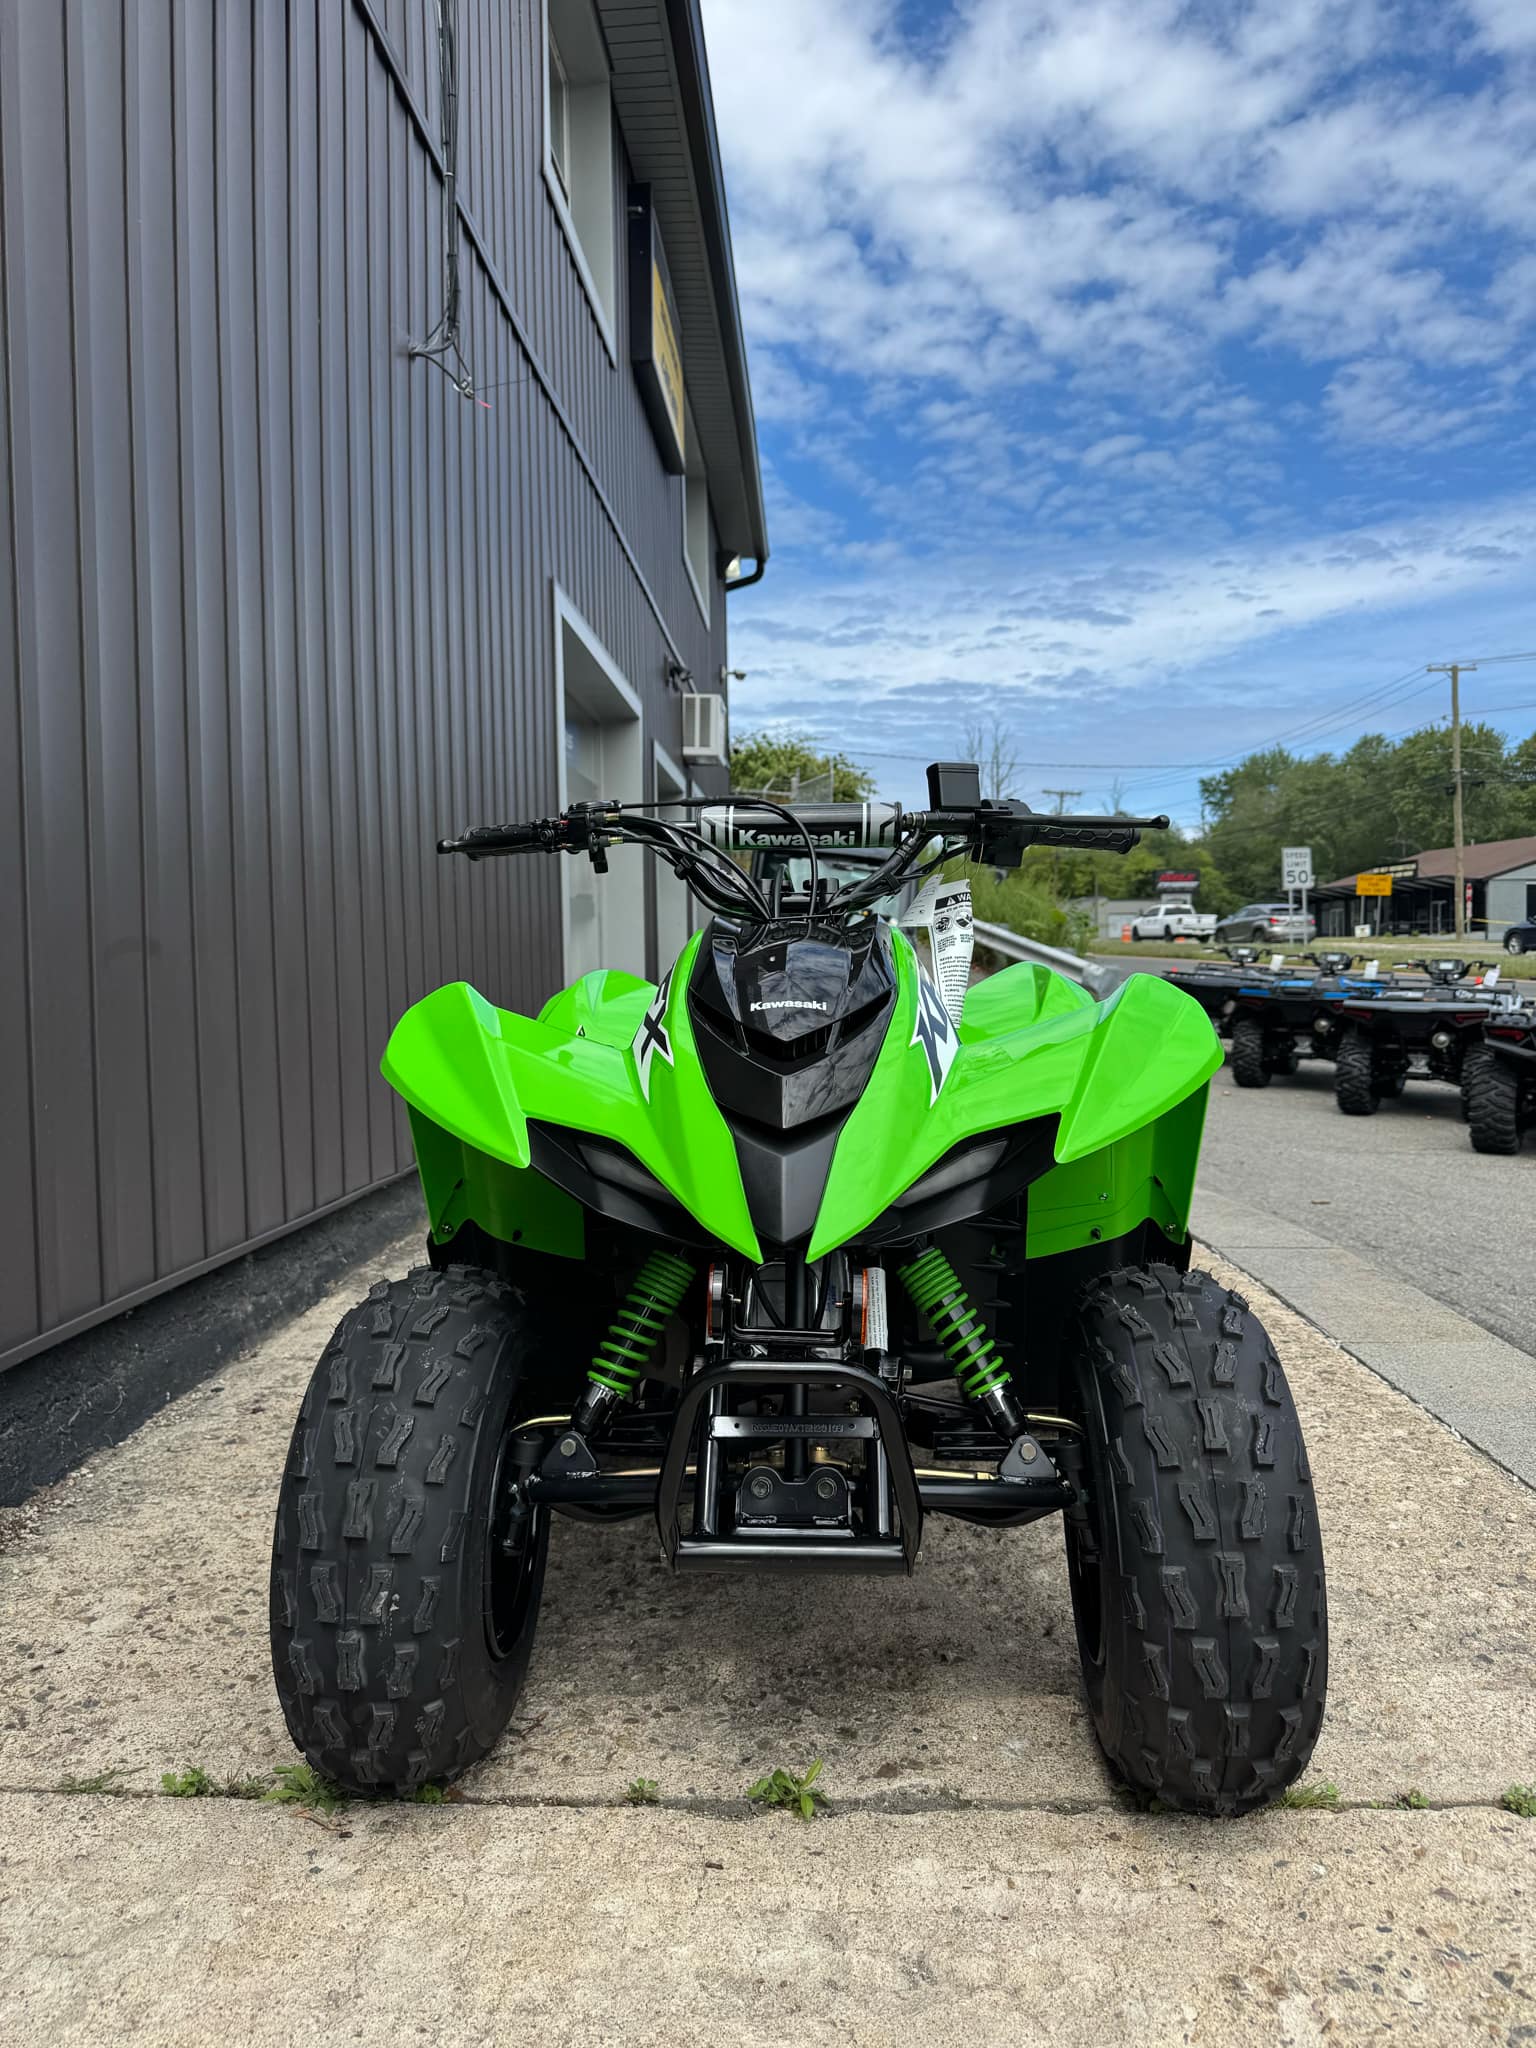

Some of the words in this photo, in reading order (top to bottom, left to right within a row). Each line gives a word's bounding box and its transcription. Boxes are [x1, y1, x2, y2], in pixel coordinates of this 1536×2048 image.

[738, 829, 856, 847] Kawasaki
[1286, 861, 1307, 869] LIMIT
[1286, 870, 1309, 884] 50
[750, 1000, 827, 1012] Kawasaki
